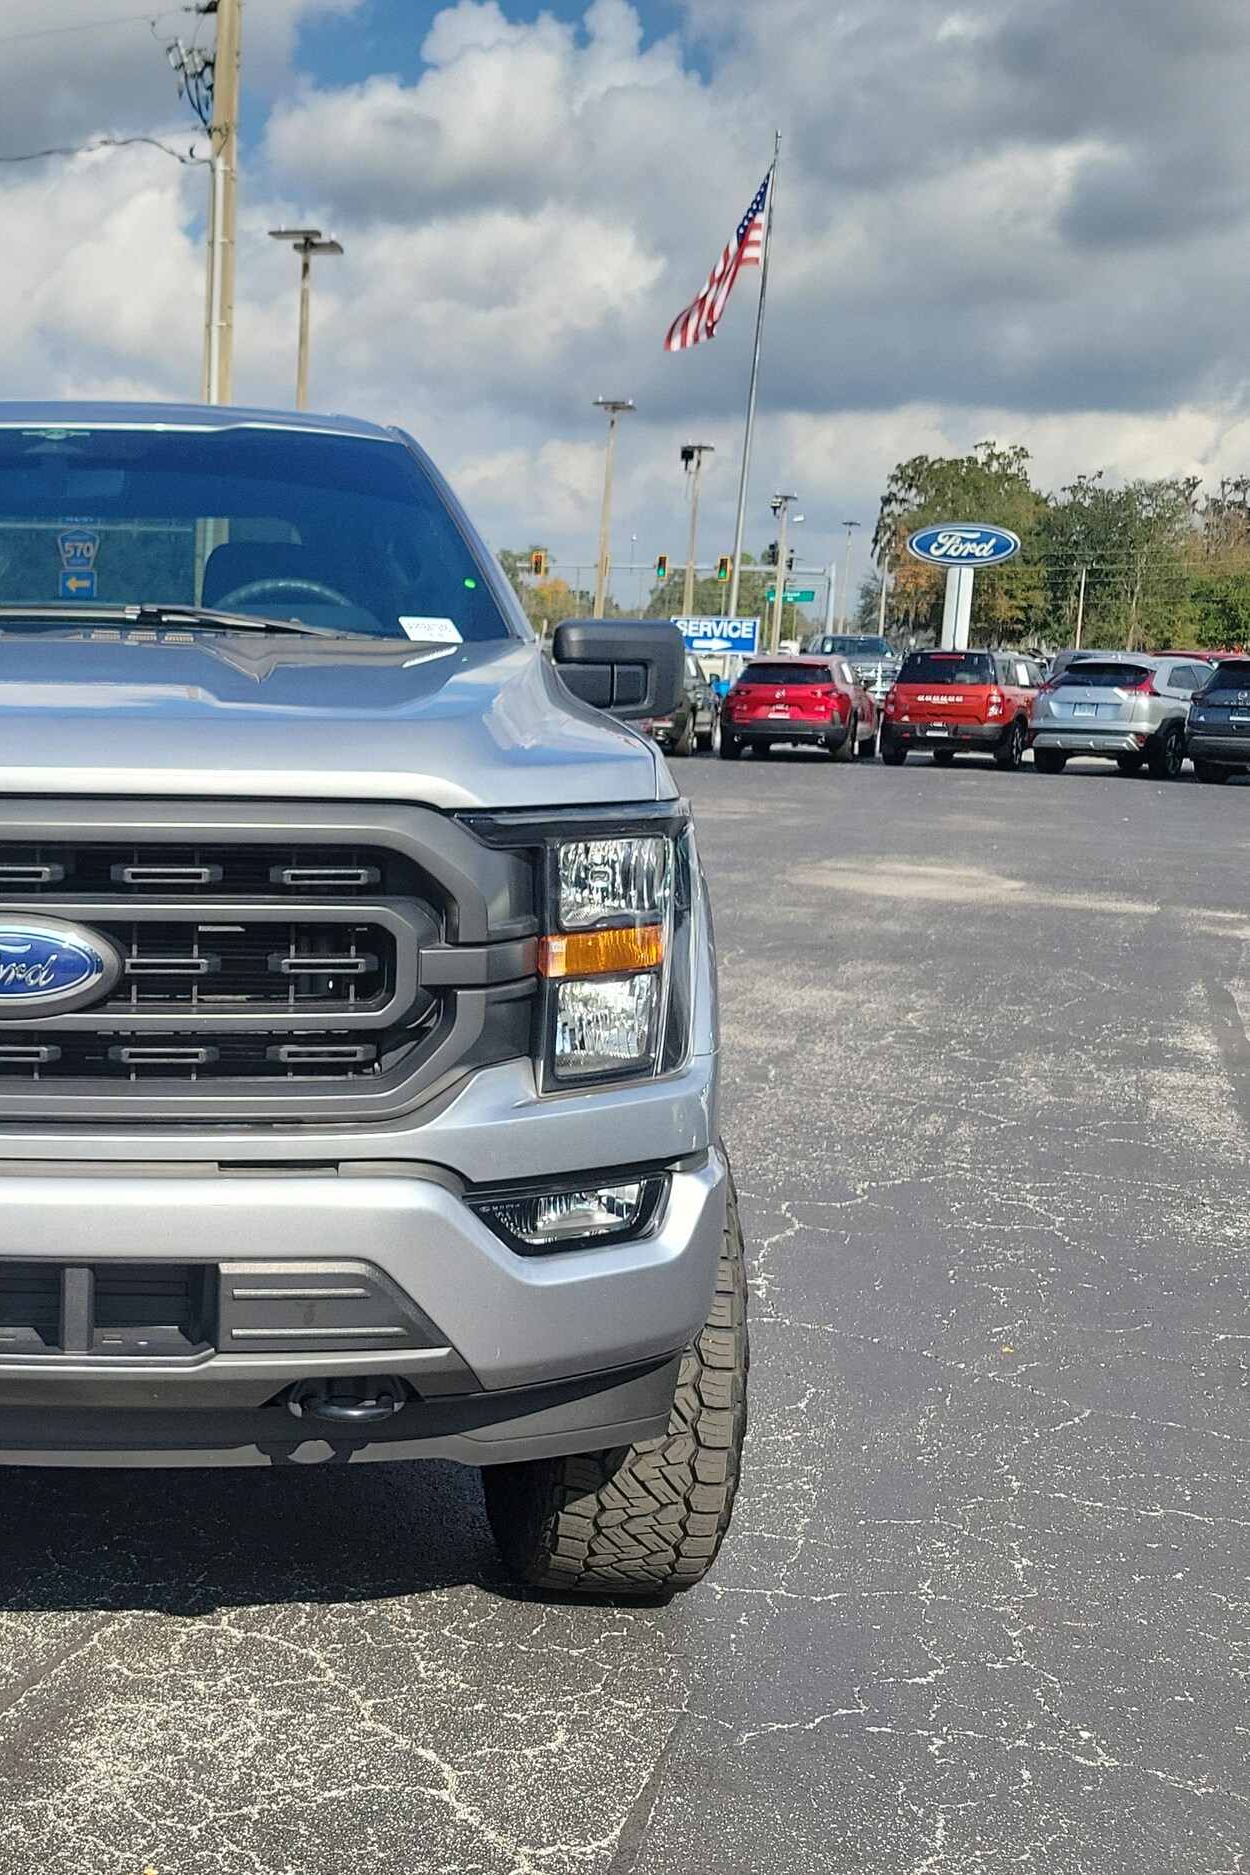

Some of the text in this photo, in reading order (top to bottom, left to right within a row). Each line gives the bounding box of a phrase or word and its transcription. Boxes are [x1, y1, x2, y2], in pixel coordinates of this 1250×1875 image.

[63, 542, 95, 558] 570
[929, 531, 997, 557] Ford
[676, 620, 754, 639] SERVICE
